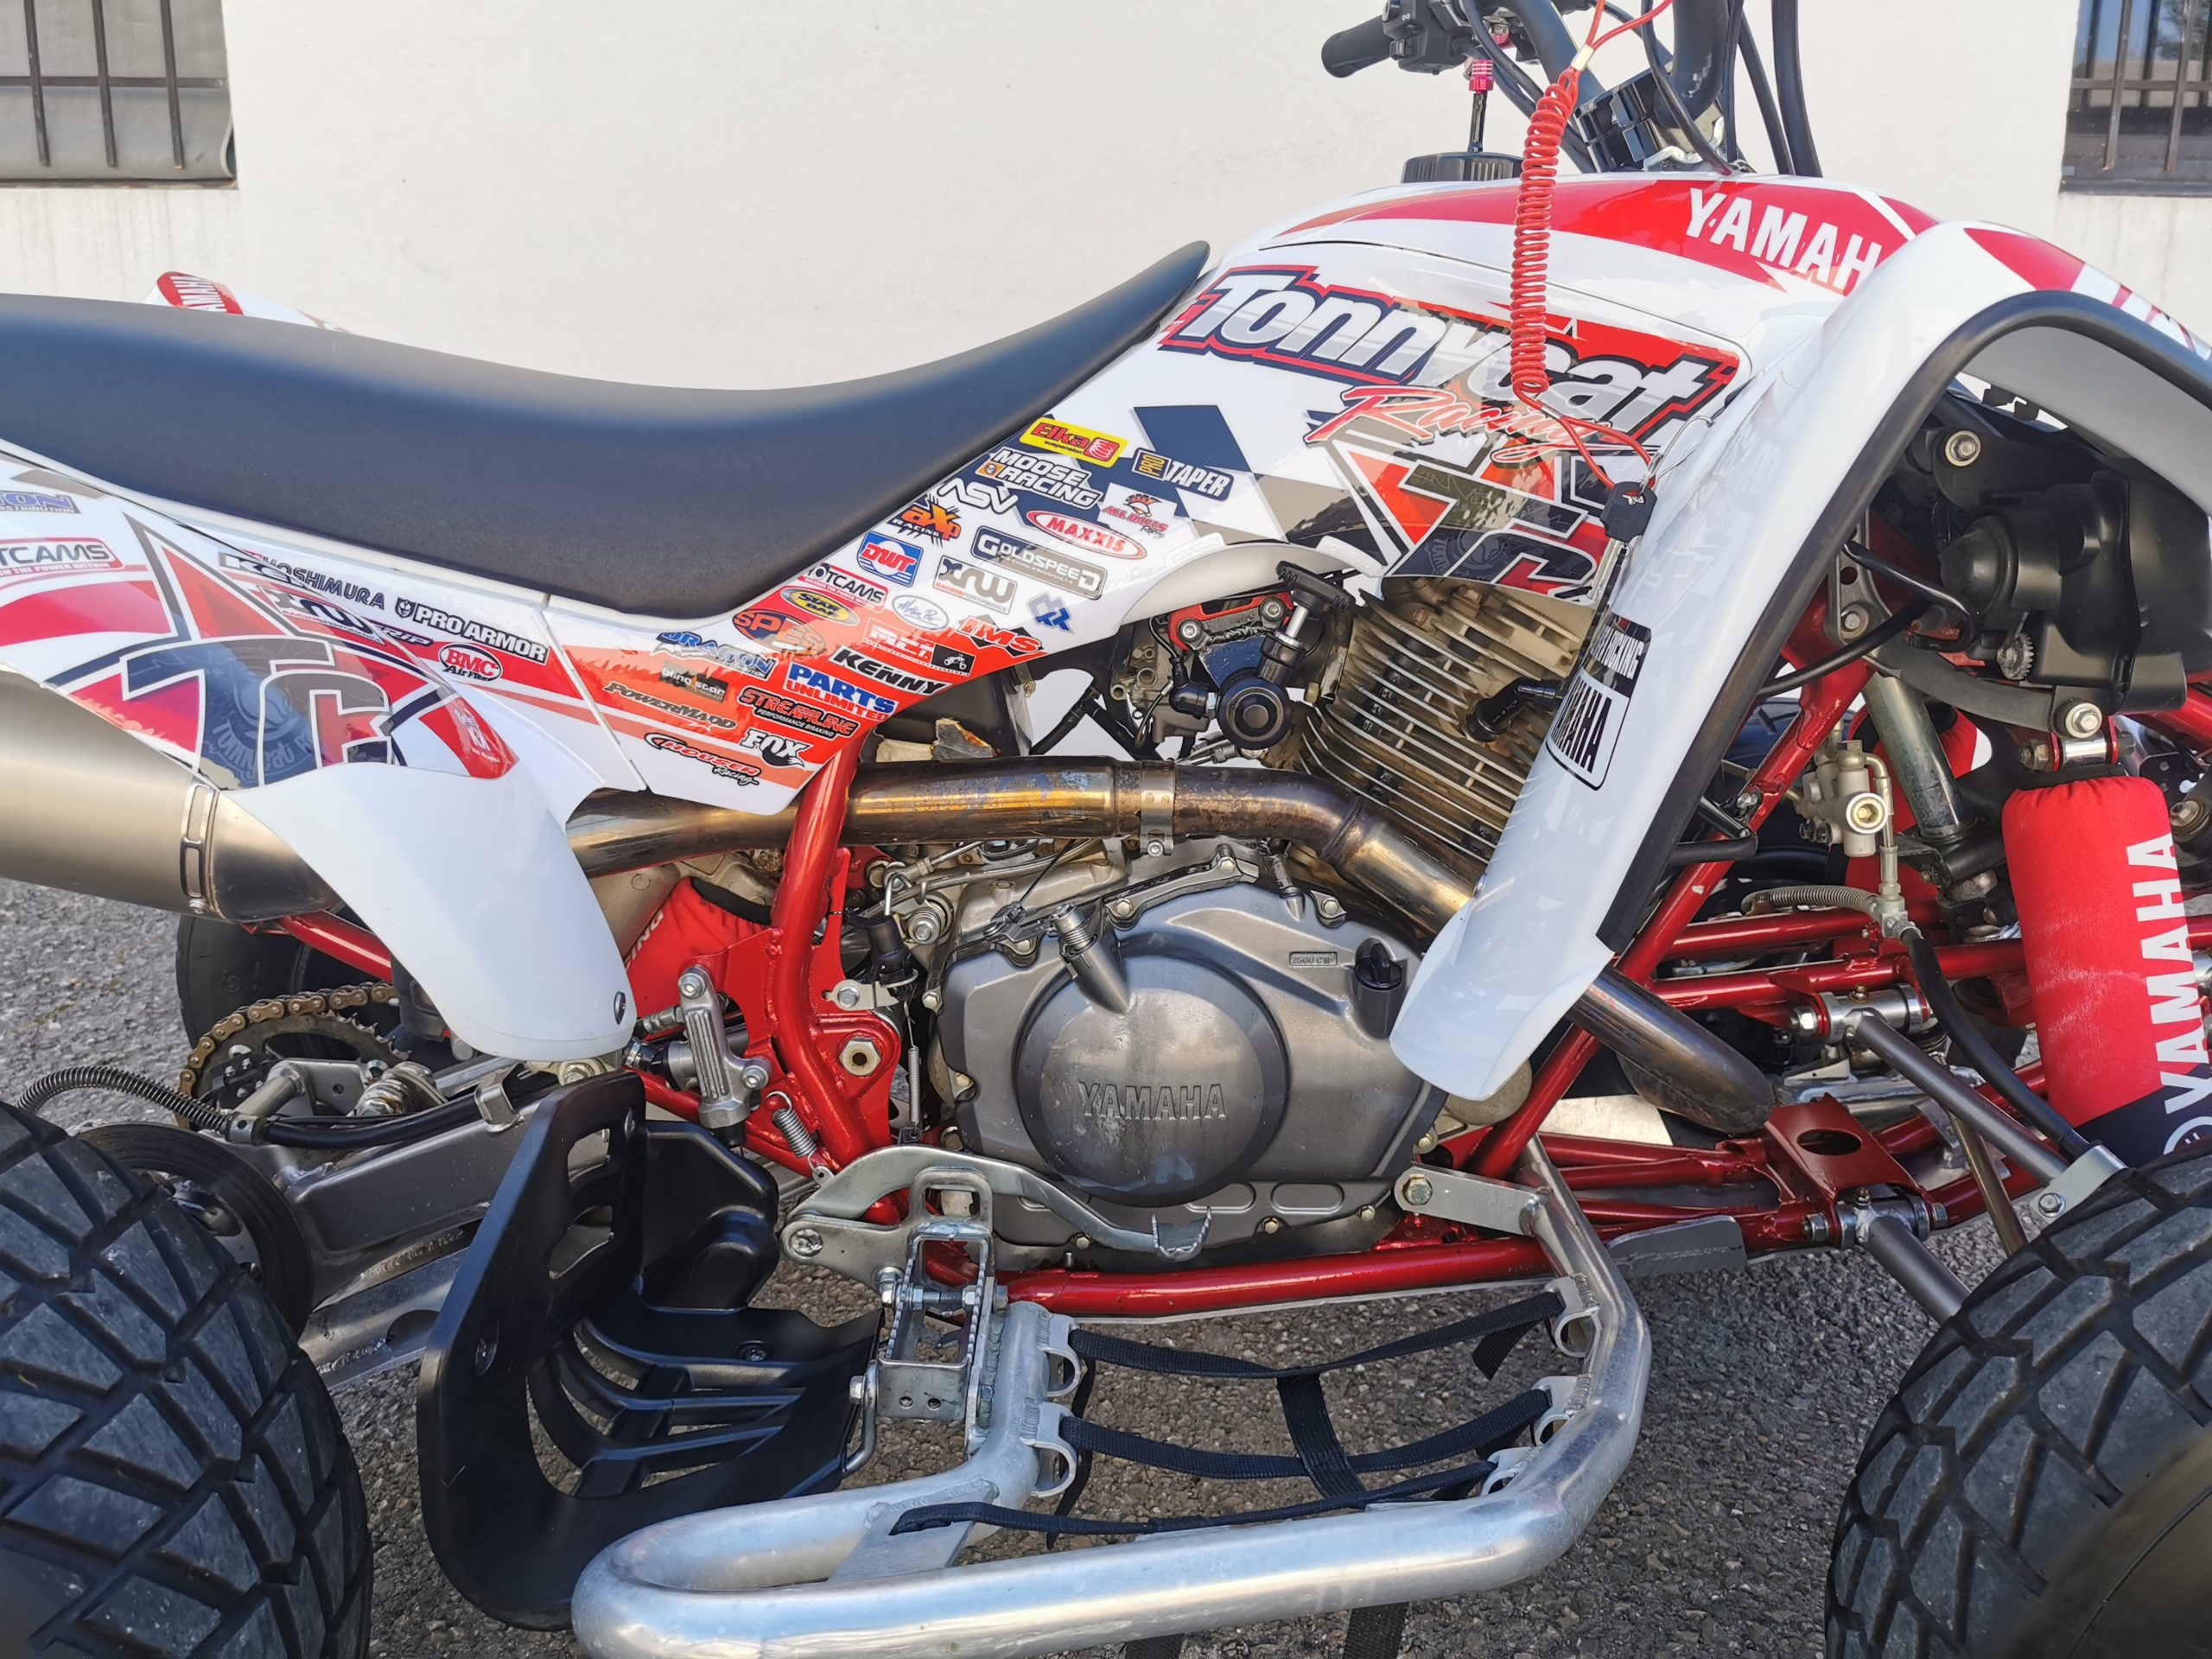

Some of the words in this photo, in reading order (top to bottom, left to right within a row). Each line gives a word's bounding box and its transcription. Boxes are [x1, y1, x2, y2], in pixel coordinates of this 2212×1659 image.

[1032, 423, 1090, 449] Elka
[991, 448, 1090, 486] MOOSE
[1139, 454, 1166, 476] PRO
[1165, 461, 1231, 497] TAPER
[996, 466, 1101, 508] RACING
[892, 518, 940, 537] RACING
[1046, 518, 1126, 553] MAXXIS
[861, 543, 917, 573] DWT
[977, 534, 1101, 592] GOLDSPEED
[415, 604, 465, 635] PRO
[464, 622, 548, 664] ARMOR
[959, 617, 1042, 652] IMS
[446, 649, 497, 677] BMC
[662, 632, 774, 674] DRAGON
[443, 664, 467, 677] Air
[467, 671, 490, 682] Filter
[662, 667, 692, 686] bling
[789, 664, 895, 714] PARTS
[741, 688, 857, 735] STREAMLINE
[786, 680, 891, 721] UNLIMITED
[756, 708, 805, 728] PERFORMANCE
[804, 722, 835, 737] BRAKING
[663, 739, 761, 775] HOUSER
[741, 728, 810, 760] FOX
[713, 764, 758, 785] Racing
[2126, 831, 2212, 1115] YAMAHA
[1077, 1080, 1226, 1121] YAMAHA
